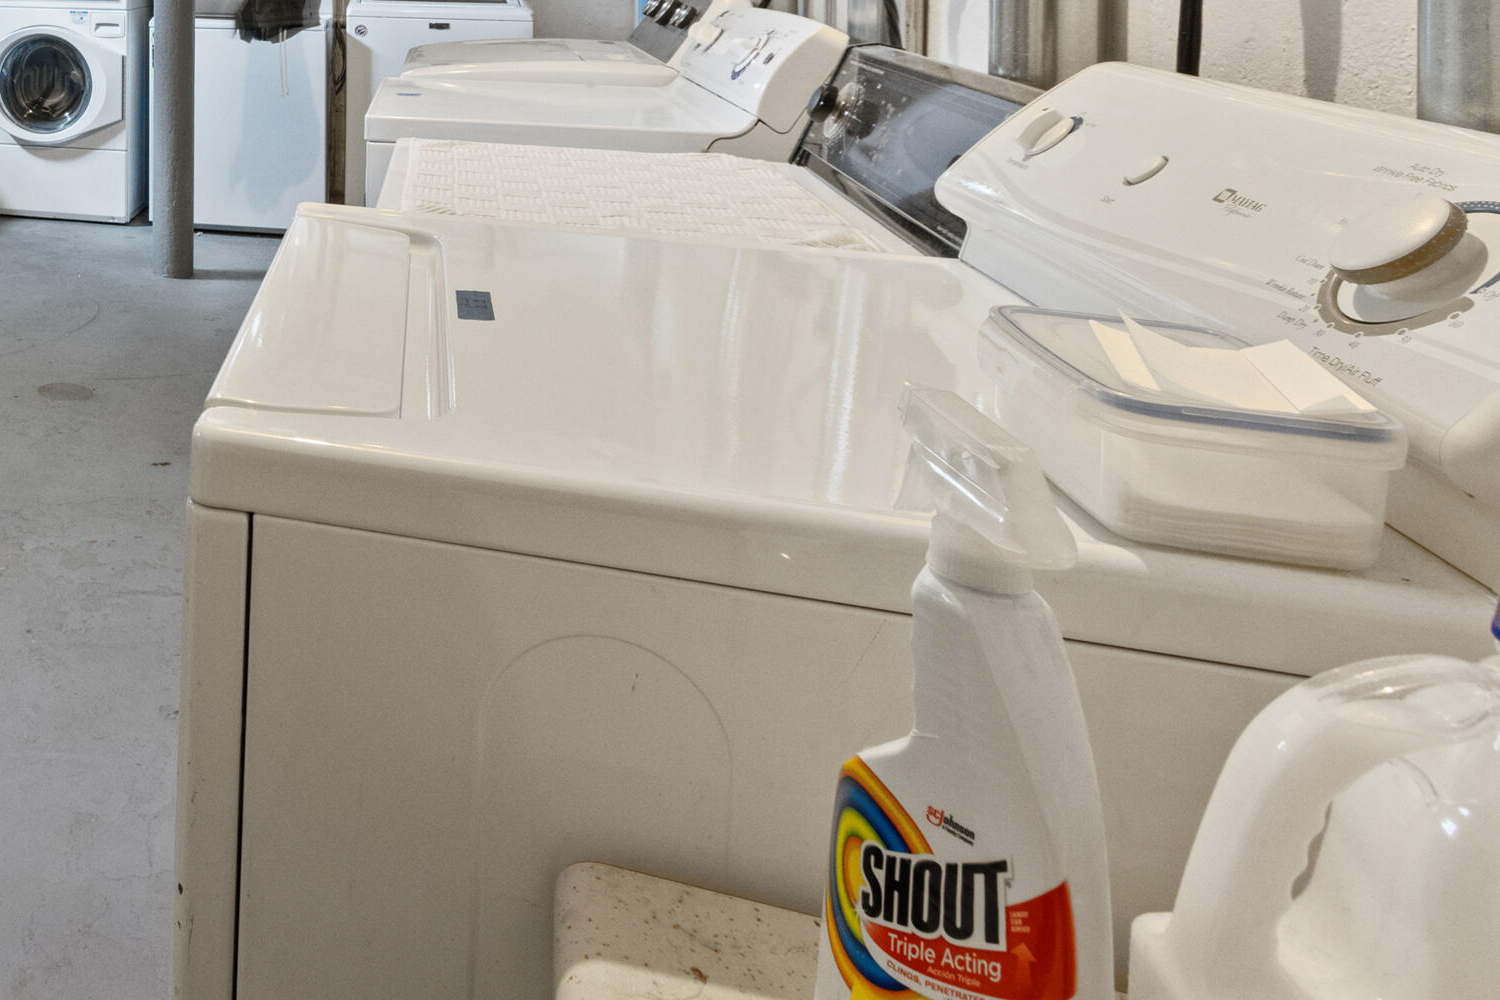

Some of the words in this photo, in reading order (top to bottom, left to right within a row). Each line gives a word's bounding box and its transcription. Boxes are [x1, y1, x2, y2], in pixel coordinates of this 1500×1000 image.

[1404, 172, 1424, 183] Free
[1428, 166, 1445, 177] Dry
[1230, 192, 1268, 212] MAYTAG
[1308, 345, 1331, 363] Time
[1357, 370, 1383, 386] Fluff
[861, 843, 1008, 945] SHOUT
[887, 931, 936, 964] Triple
[940, 947, 1002, 983] Acting
[885, 960, 923, 986] CLINGS,
[926, 966, 956, 981] Acción
[957, 974, 981, 987] Triple
